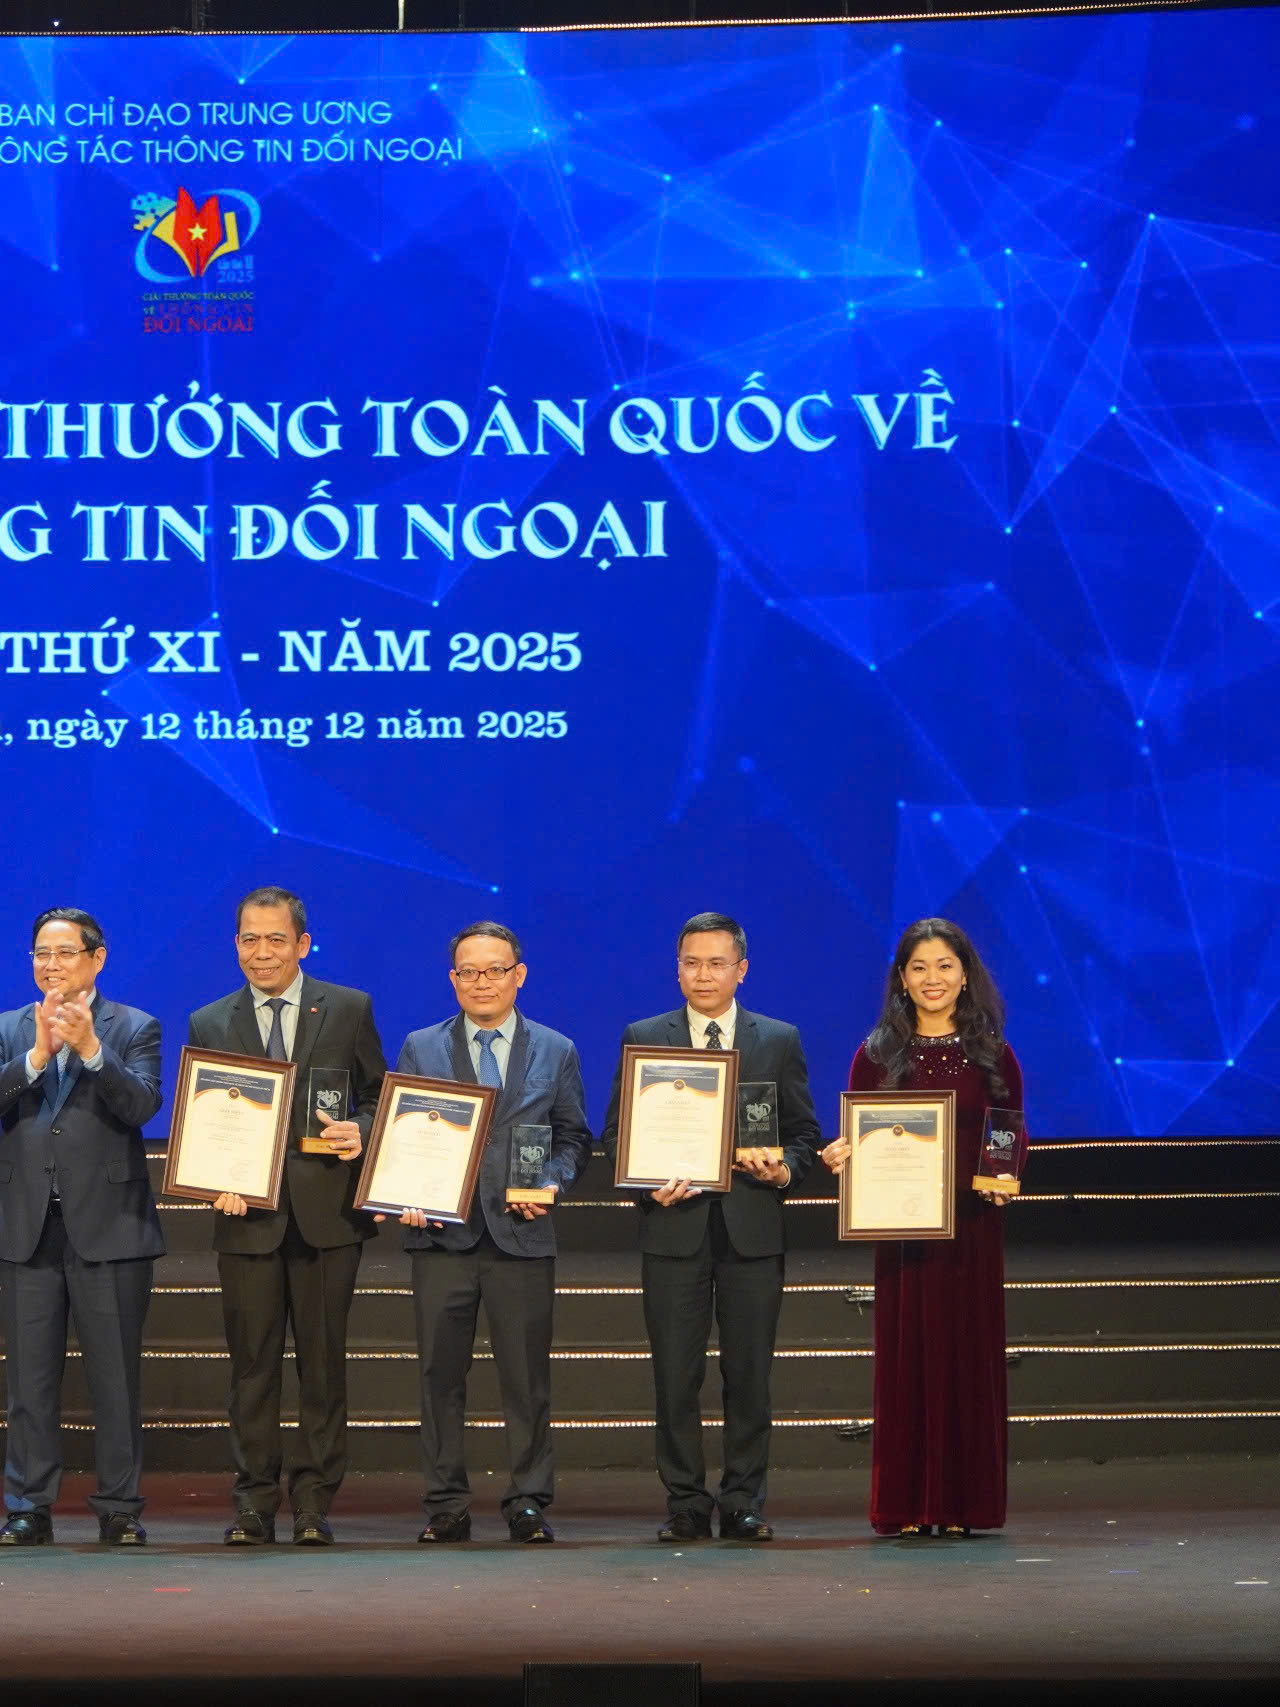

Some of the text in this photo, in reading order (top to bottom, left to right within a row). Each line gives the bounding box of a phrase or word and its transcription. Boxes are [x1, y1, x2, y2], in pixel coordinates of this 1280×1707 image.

[65, 96, 115, 127] CHỈ
[122, 103, 191, 133] ĐẠO
[199, 102, 295, 126] TRUNG
[303, 101, 393, 125] ƯƠNG
[76, 135, 133, 164] TÁC
[141, 134, 245, 164] THÔNG
[253, 140, 293, 162] TIN
[301, 130, 355, 163] ĐỐI
[364, 138, 464, 168] NGOẠI
[361, 386, 587, 458] TOÀN
[609, 370, 836, 456] QUỐC
[851, 368, 958, 453] VỀ
[72, 502, 211, 563] TIN
[229, 480, 379, 562] ĐỐI
[402, 499, 668, 572] NGOẠI
[147, 630, 221, 674] XI
[241, 653, 260, 662] -
[278, 618, 431, 673] NĂM
[448, 632, 583, 673] 2025
[27, 709, 129, 749] ngày
[141, 712, 181, 740] 12
[193, 709, 313, 748] tháng
[325, 712, 365, 739] 12
[377, 709, 465, 739] năm
[477, 711, 568, 739] 2025
